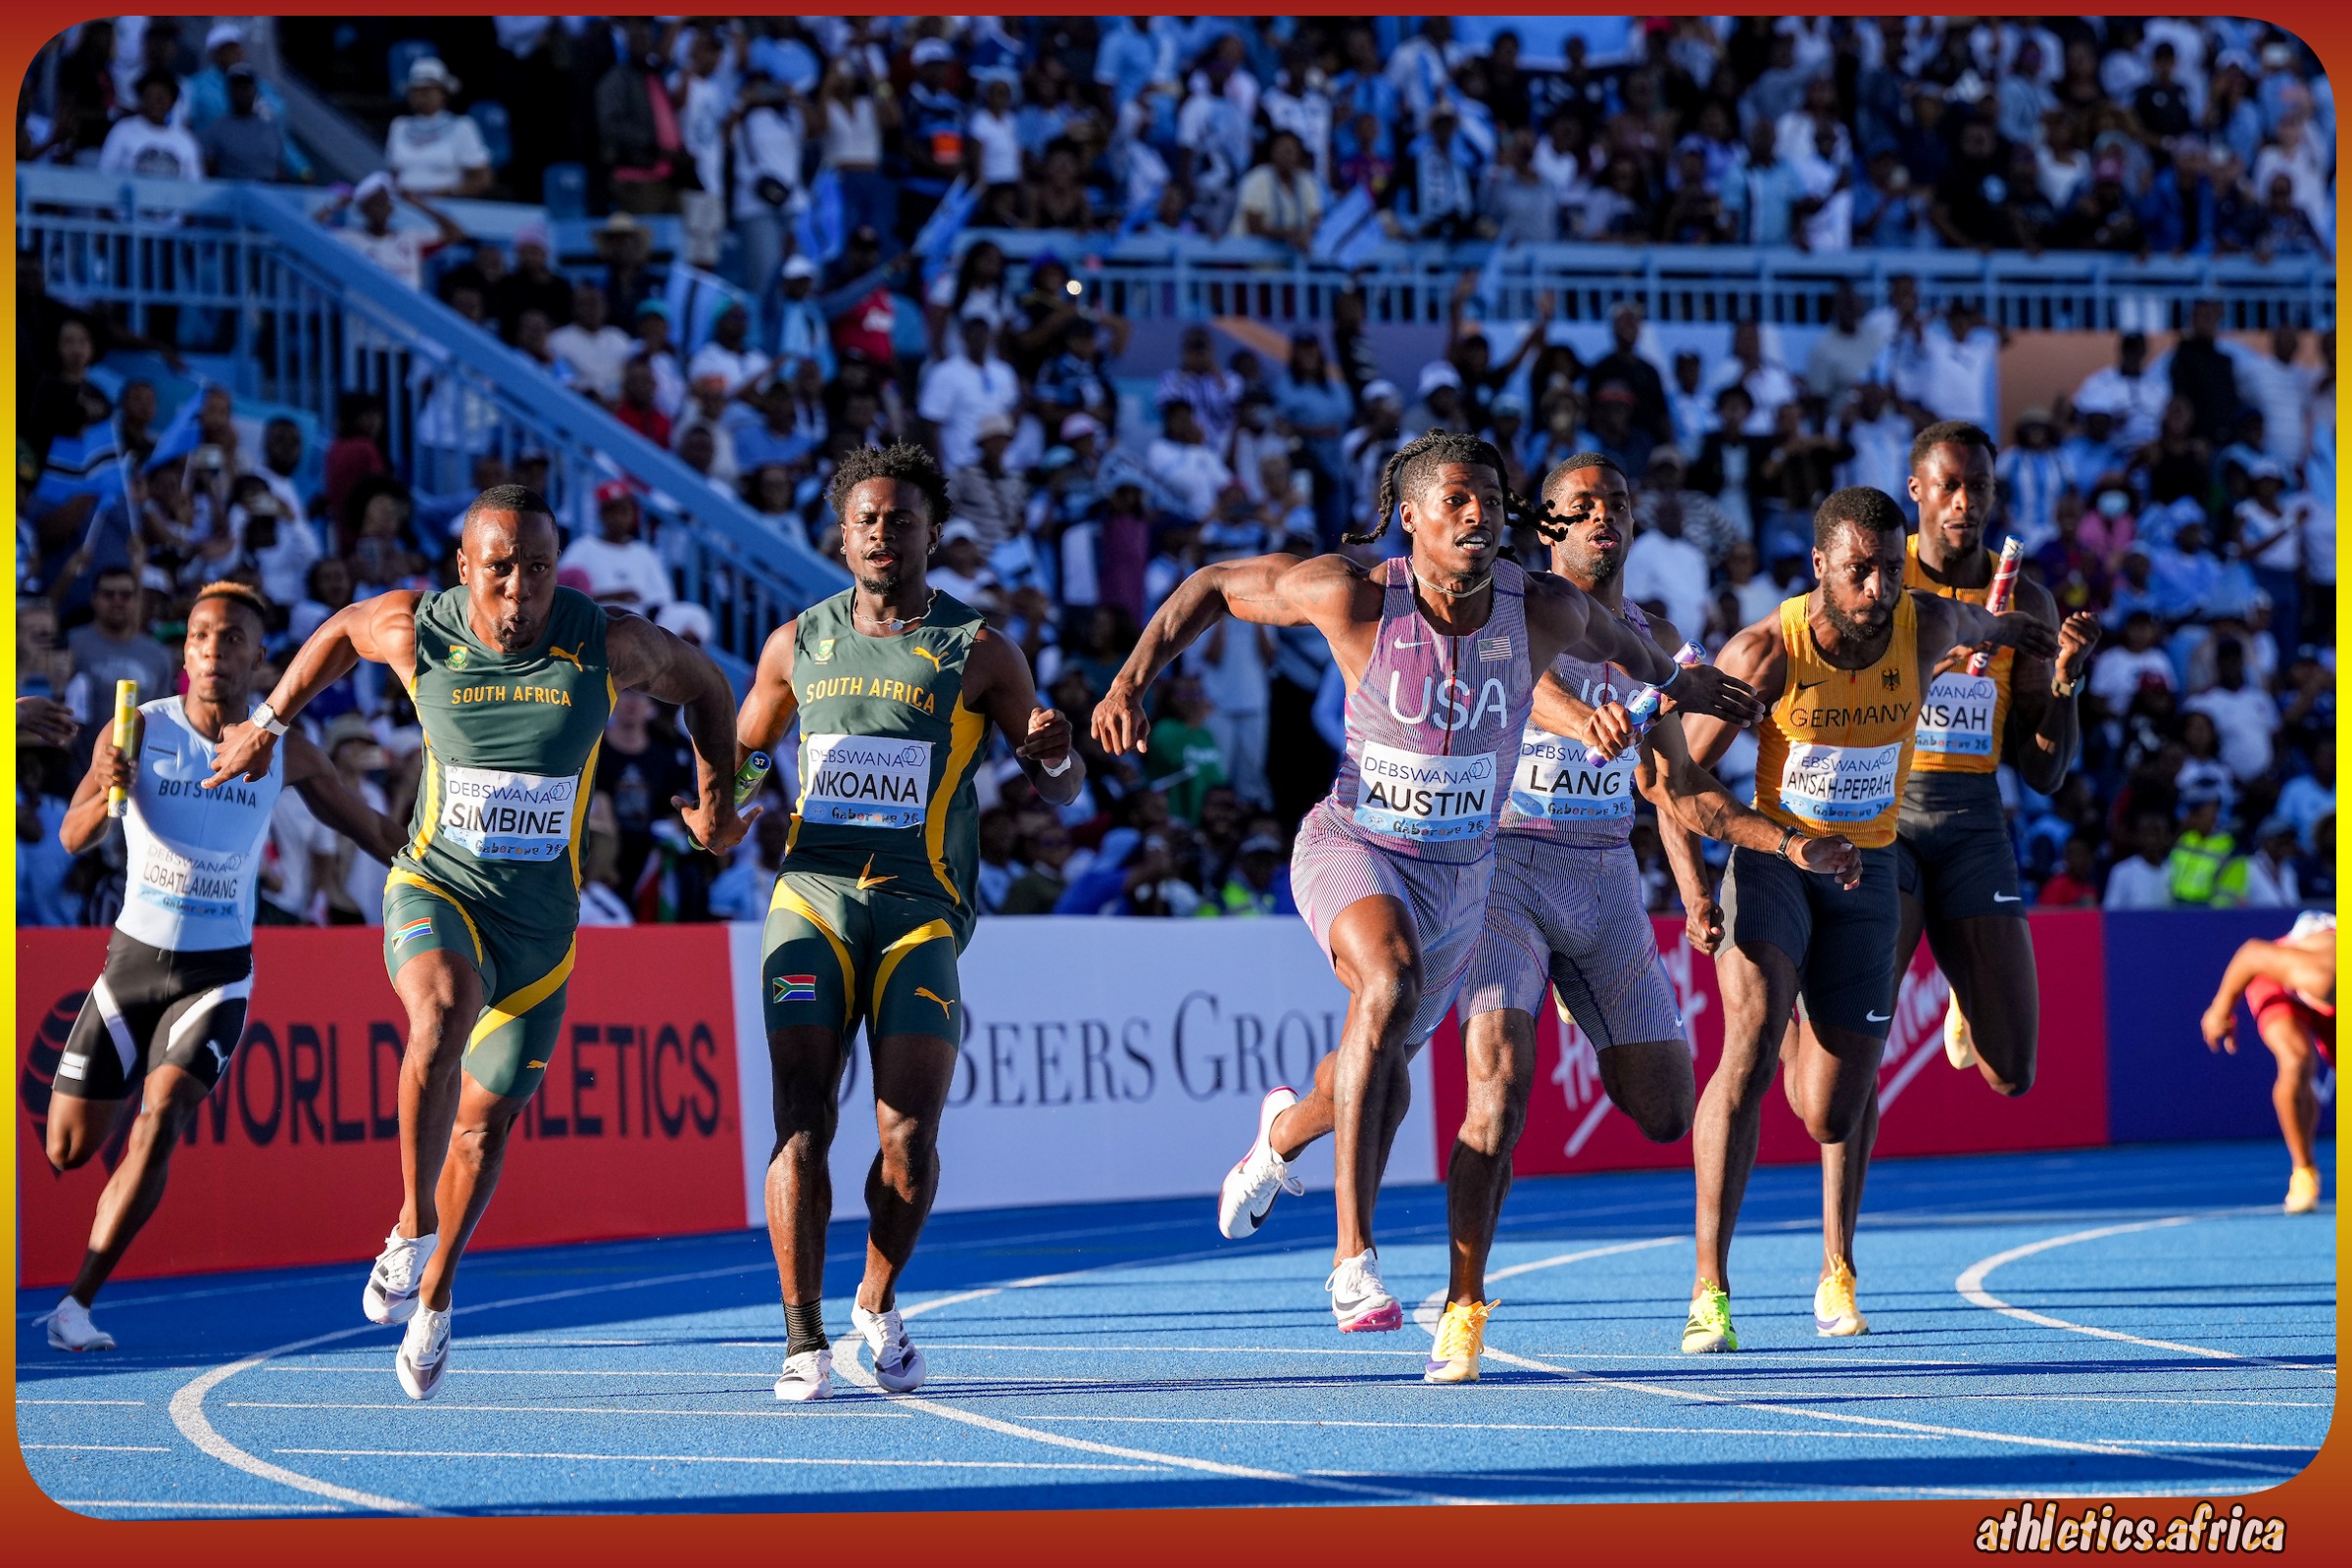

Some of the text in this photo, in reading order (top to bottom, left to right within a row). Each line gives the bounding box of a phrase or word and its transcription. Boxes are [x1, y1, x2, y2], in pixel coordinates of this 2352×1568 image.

[452, 685, 572, 707] SOUTH AFRICA
[807, 676, 935, 713] SOUTH AFRICA
[1389, 669, 1508, 731] USA
[1928, 684, 1977, 700] WANA
[1789, 701, 1912, 728] GERMANY
[1918, 704, 1987, 731] NSAH
[810, 748, 905, 768] DEBSWANA
[1521, 742, 1590, 763] DEBSW
[1975, 739, 1989, 751] 26
[754, 757, 765, 766] 37
[1364, 756, 1471, 785] DEBSWANA
[1790, 751, 1881, 772] DEBSWANA
[158, 778, 257, 808] BOTSWANA
[449, 780, 552, 805] DEBSWANA
[810, 770, 919, 804] NKOANA
[1529, 764, 1622, 797] LANG
[1787, 770, 1893, 800] ANSAH-PEPRAH
[1365, 781, 1486, 816] AUSTIN
[1547, 801, 1628, 815] Gaborone 26
[1813, 805, 1872, 818] Gaborone
[448, 802, 565, 834] SIMBINE
[832, 807, 919, 824] Gaborone 26
[1393, 819, 1485, 837] Gaborone 26
[147, 843, 227, 873] DEBSWANA
[474, 840, 539, 856] Gaborone
[143, 861, 237, 900] LOBATLAMANG
[1173, 989, 1337, 1103] GRO
[522, 1020, 720, 1141] LETICS
